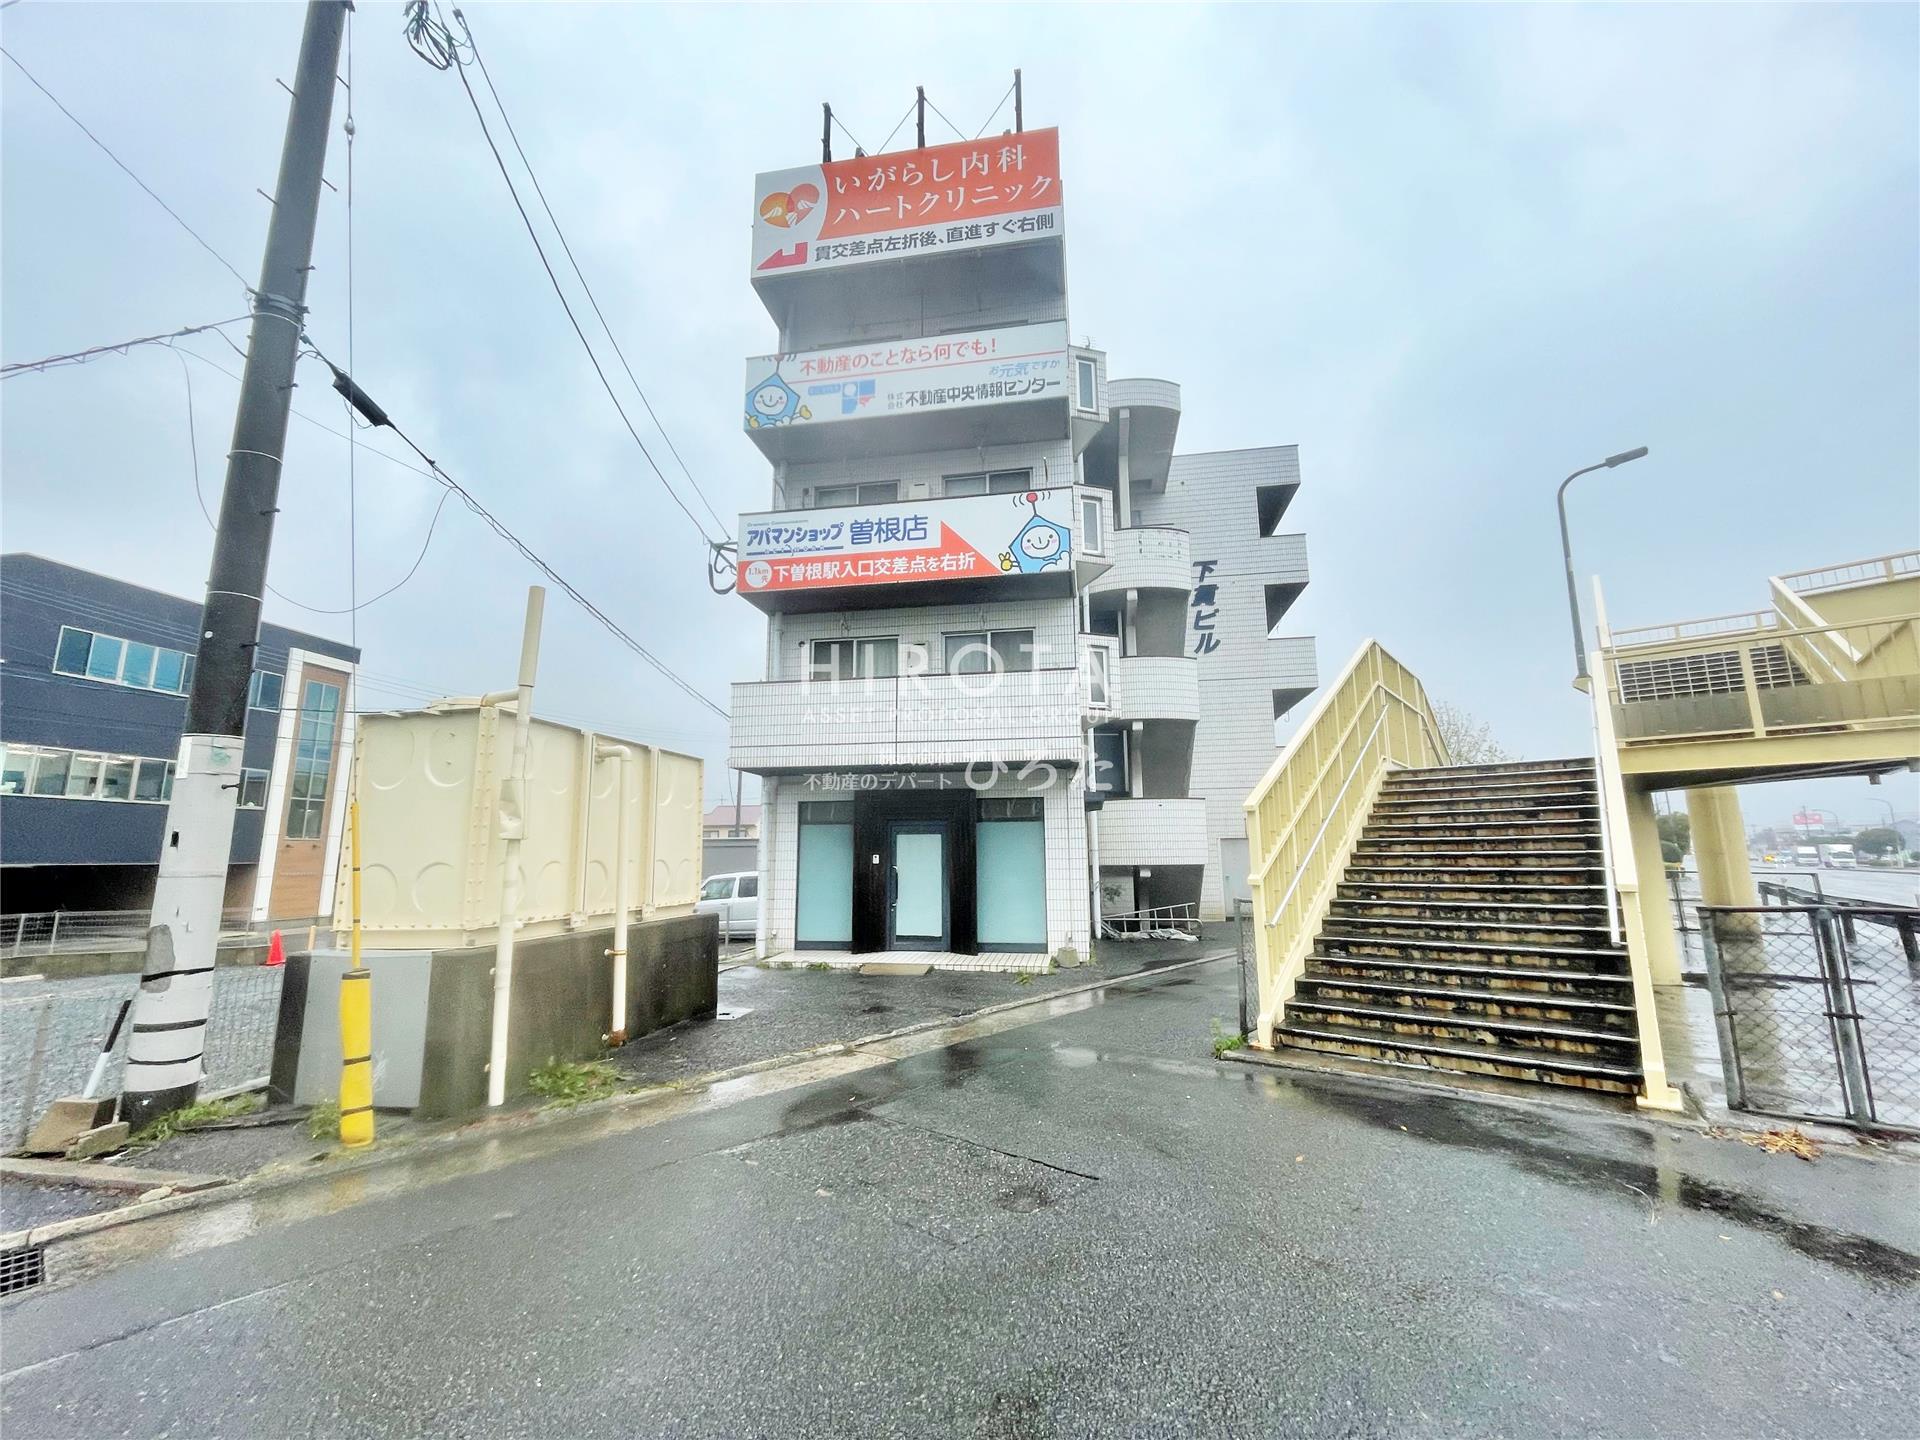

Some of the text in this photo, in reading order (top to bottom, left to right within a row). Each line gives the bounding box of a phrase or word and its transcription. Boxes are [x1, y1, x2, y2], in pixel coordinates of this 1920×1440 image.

[834, 144, 1027, 194] いがらし内科
[832, 175, 1053, 225] ハートクリニック
[904, 378, 1061, 408] 不動産中央情報センター
[746, 513, 929, 547] アパマンショップ 曽根店
[773, 552, 976, 583] 下曽根駅入口交差点を右折
